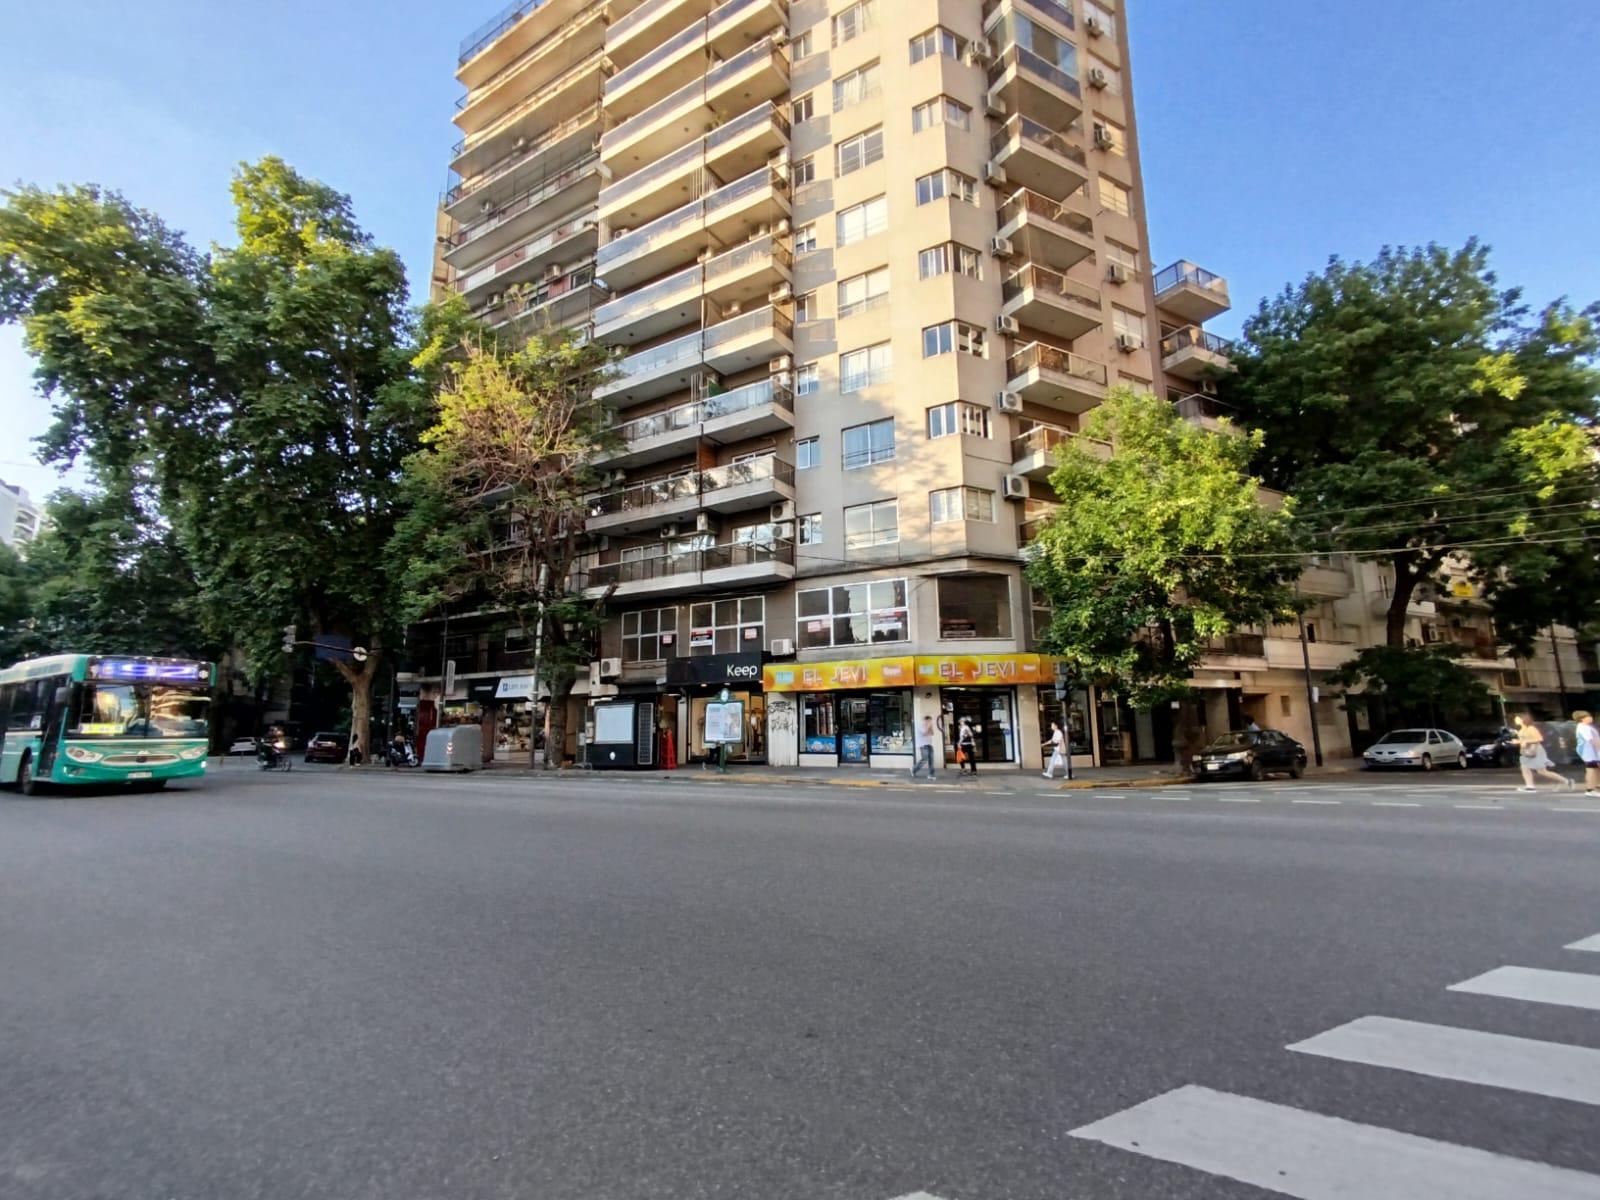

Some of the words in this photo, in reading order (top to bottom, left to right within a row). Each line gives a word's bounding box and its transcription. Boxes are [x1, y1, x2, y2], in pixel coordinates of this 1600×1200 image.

[726, 664, 758, 679] Keep
[803, 668, 822, 682] EL
[832, 665, 868, 682] JEVI
[939, 662, 964, 678] EL
[972, 661, 1016, 678] JEVI
